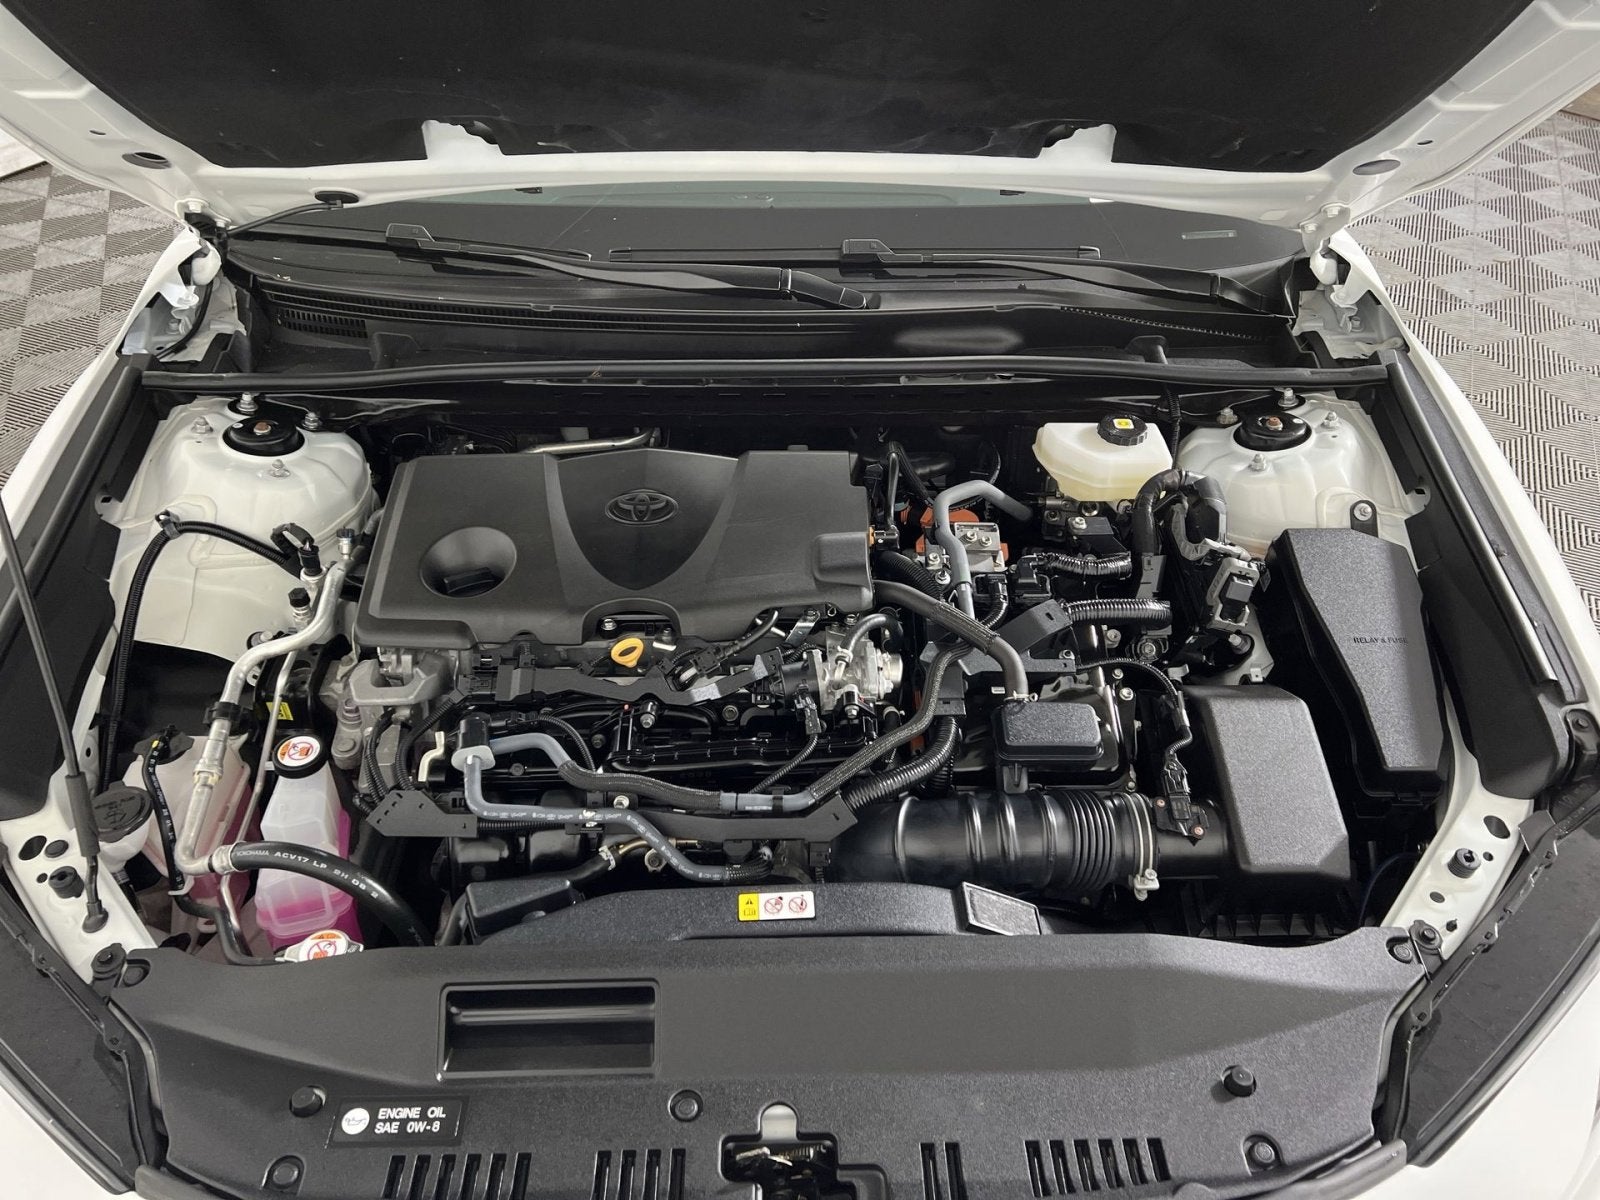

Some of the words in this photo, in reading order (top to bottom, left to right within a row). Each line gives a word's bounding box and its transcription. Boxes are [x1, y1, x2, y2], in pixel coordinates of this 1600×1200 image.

[274, 851, 310, 863] ACV17
[313, 860, 328, 869] LP
[377, 1107, 422, 1119] ENGINE
[427, 1106, 446, 1118] OIL
[374, 1122, 400, 1134] SAE
[406, 1121, 441, 1133] 0W-8
